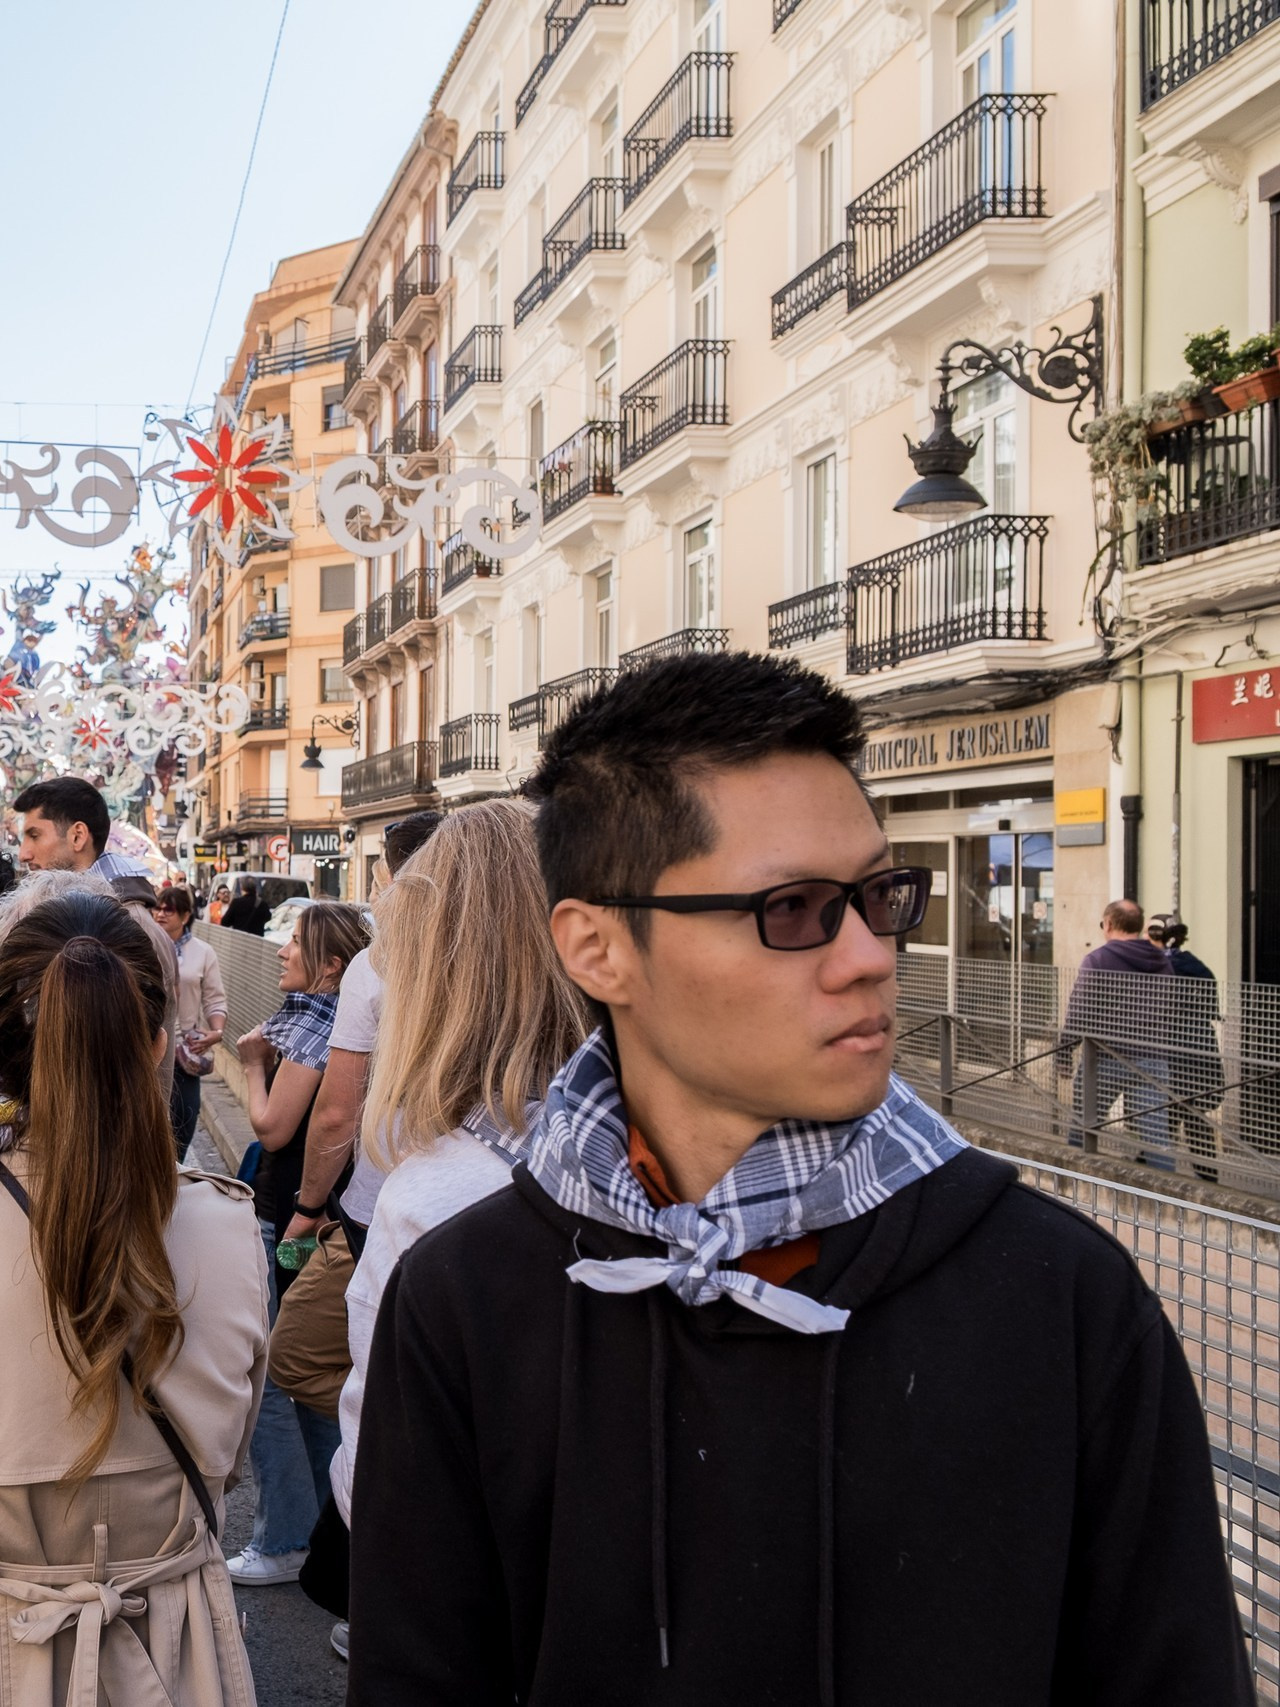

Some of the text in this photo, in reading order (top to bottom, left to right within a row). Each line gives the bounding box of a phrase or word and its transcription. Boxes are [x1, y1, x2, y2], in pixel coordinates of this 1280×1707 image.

[1231, 672, 1280, 707] 兰妮
[946, 713, 1051, 762] JERUSALEM
[302, 834, 339, 851] HAIR
